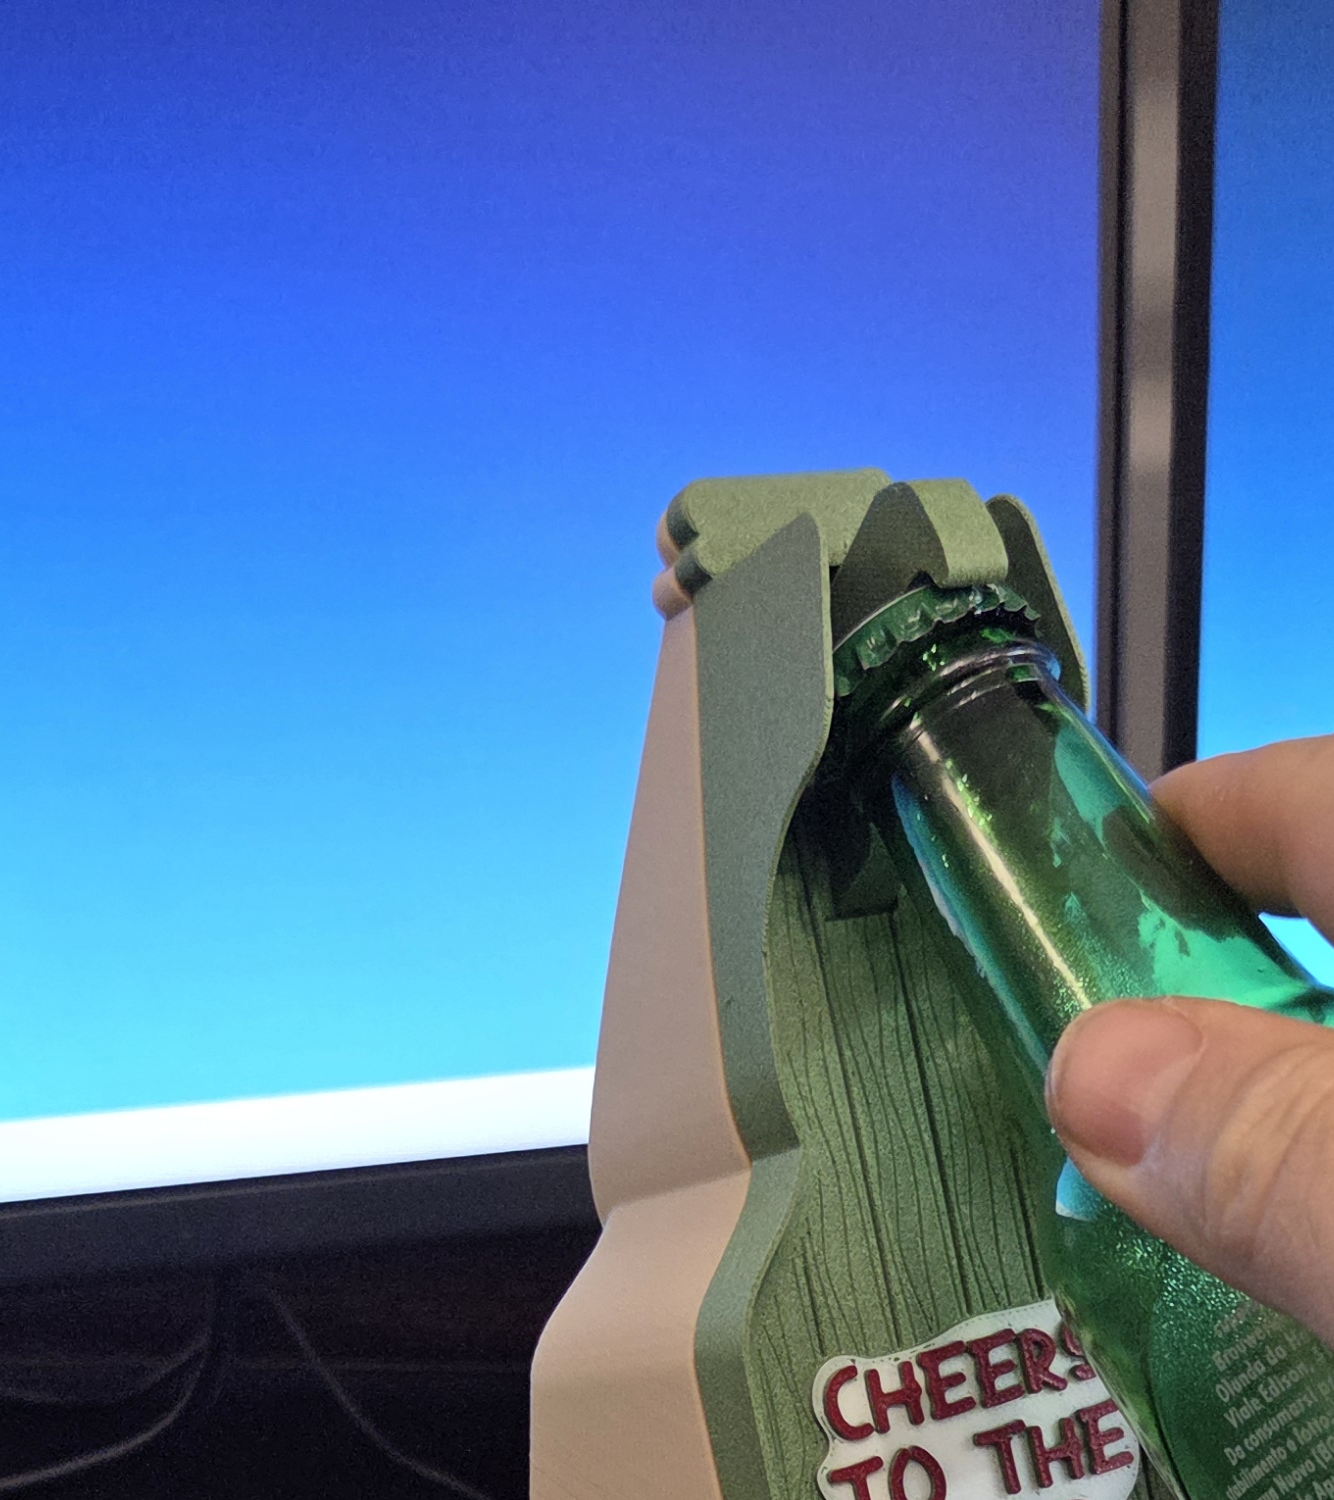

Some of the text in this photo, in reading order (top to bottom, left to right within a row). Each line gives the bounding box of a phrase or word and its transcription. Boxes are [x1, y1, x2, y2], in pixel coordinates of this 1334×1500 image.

[1221, 1390, 1264, 1431] Viale
[972, 1399, 1135, 1495] THE
[1221, 1439, 1247, 1466] Da
[1271, 1453, 1317, 1495] Nuovo
